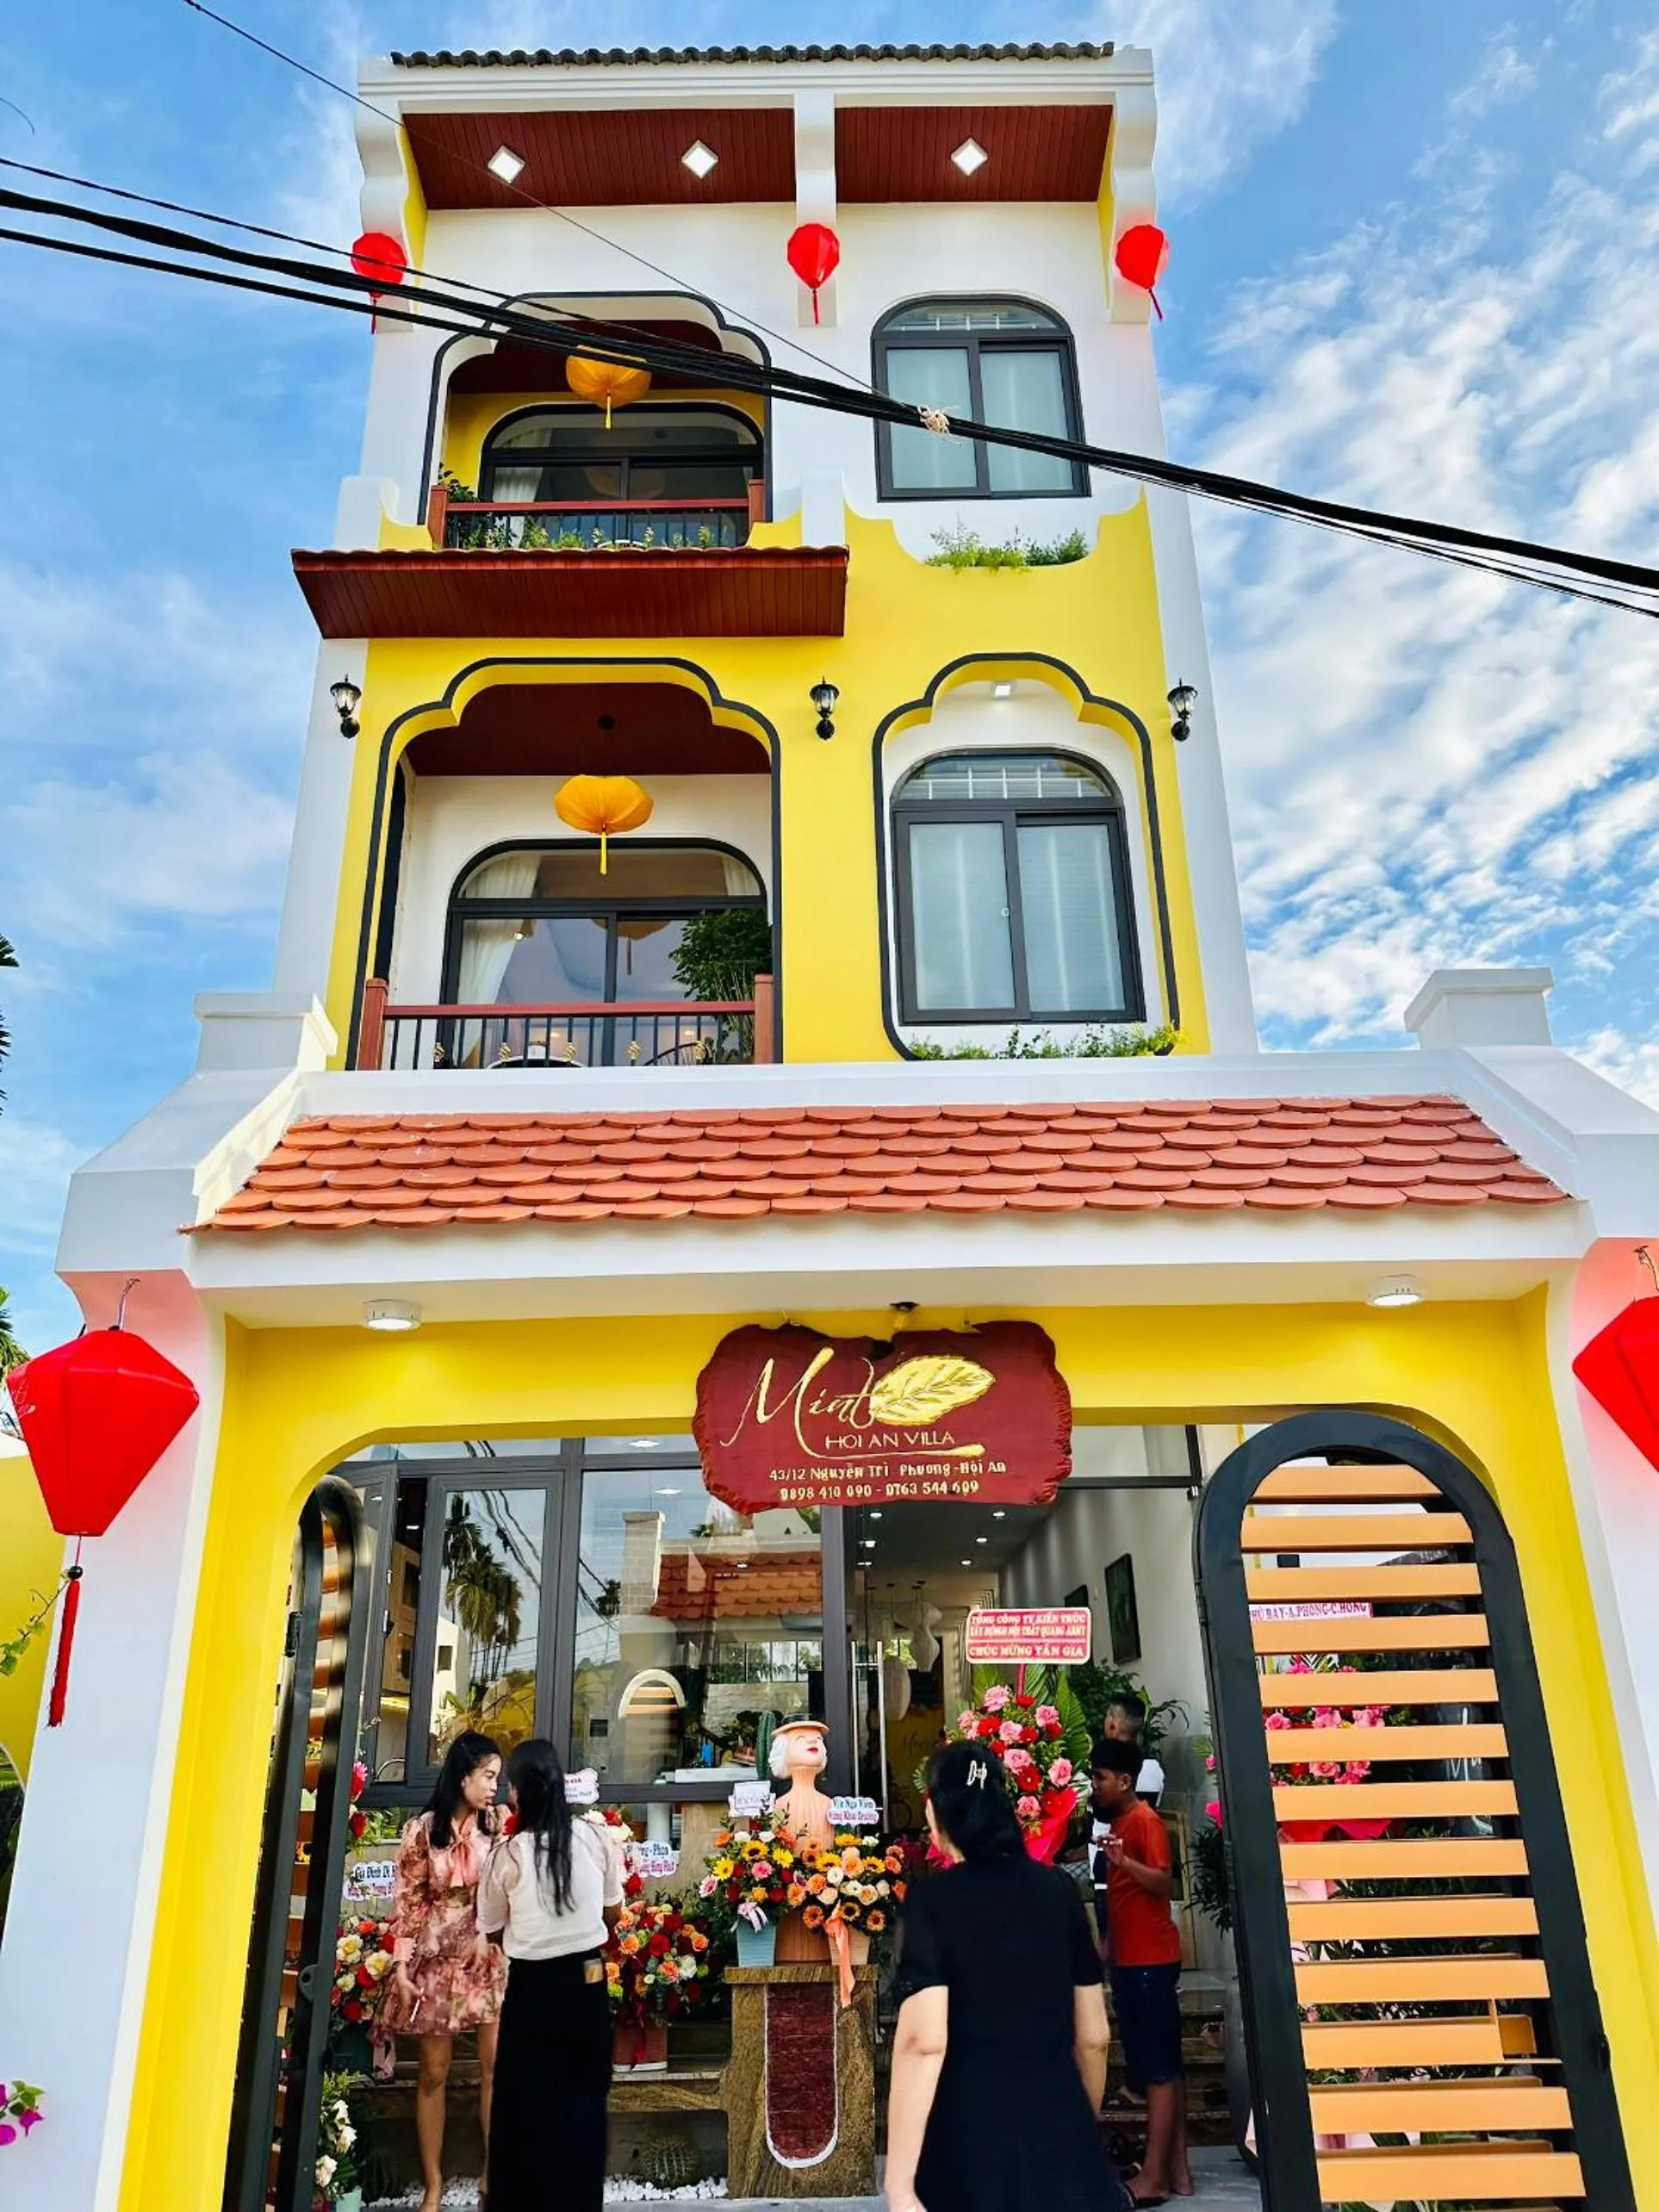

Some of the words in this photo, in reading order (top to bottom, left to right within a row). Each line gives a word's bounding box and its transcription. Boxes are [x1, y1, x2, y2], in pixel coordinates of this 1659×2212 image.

[720, 1346, 882, 1449] Mint
[824, 1434, 862, 1450] HOI
[868, 1432, 899, 1448] AN
[904, 1430, 955, 1446] VILLA
[769, 1468, 806, 1482] 43/12
[988, 1461, 1007, 1473] An
[780, 1487, 814, 1501] 0898
[818, 1485, 842, 1500] 410
[923, 1481, 948, 1495] 544
[969, 1644, 998, 1656] CHÚC
[1062, 1644, 1084, 1656] GIA
